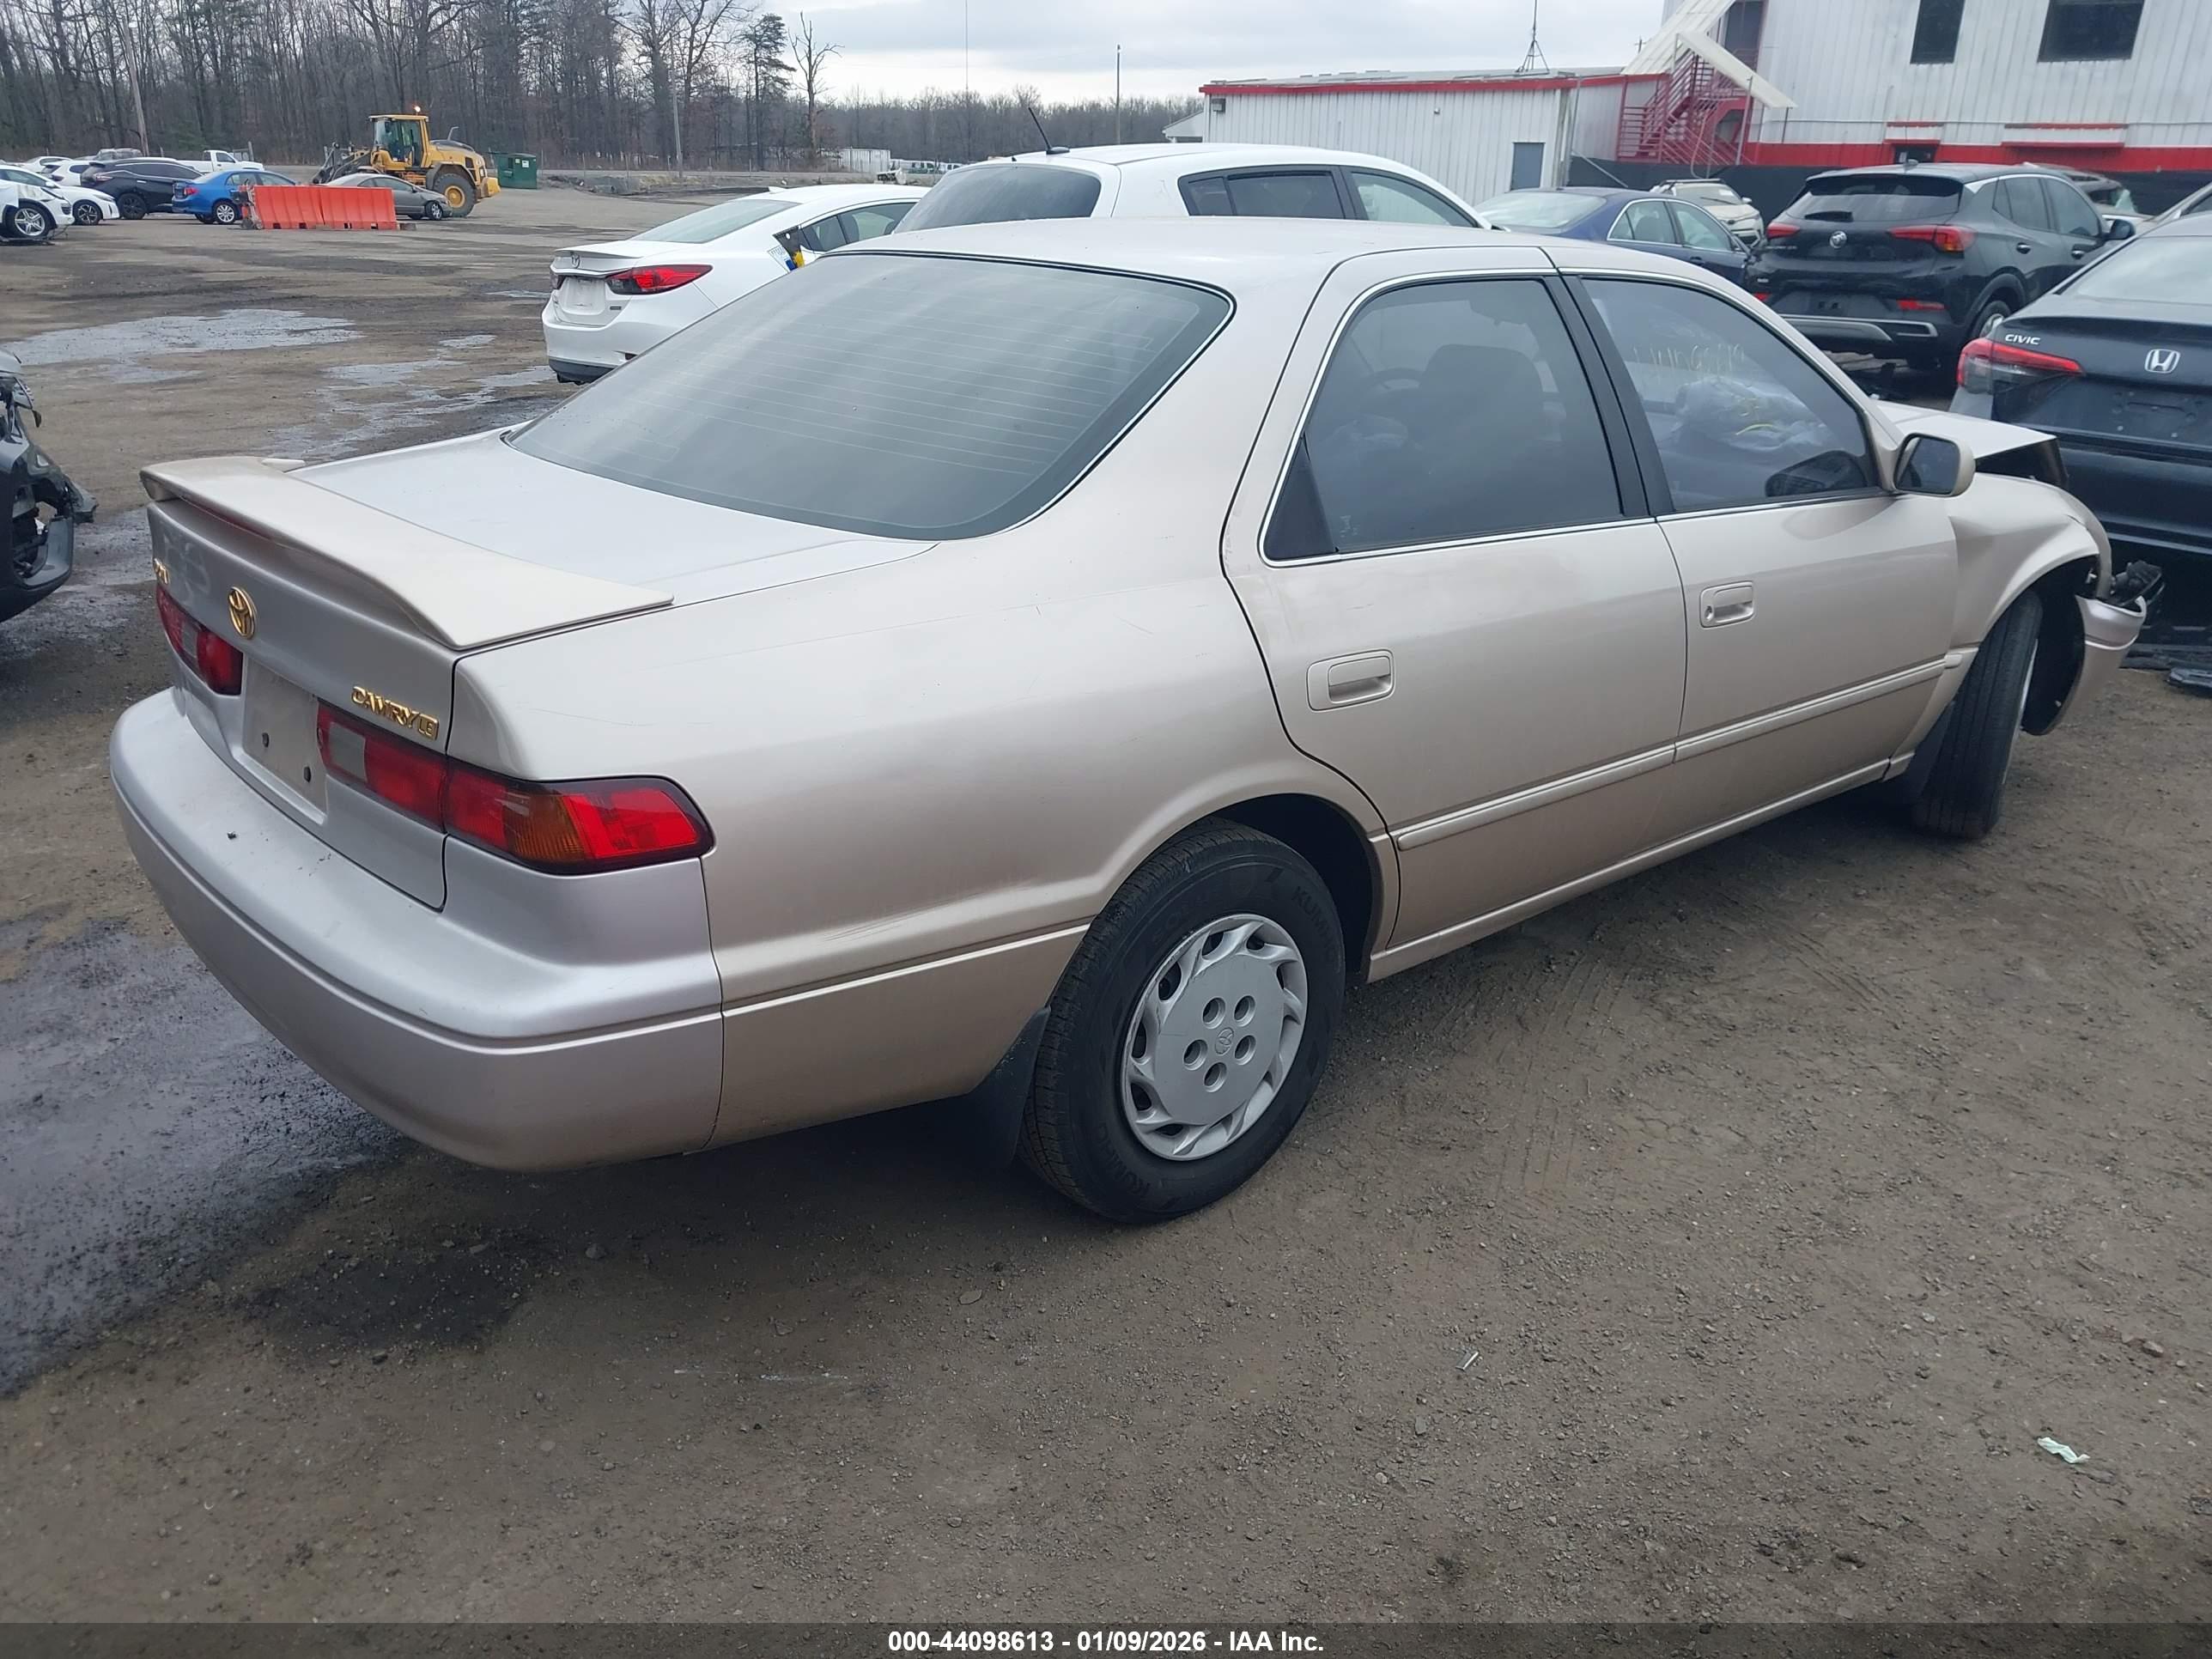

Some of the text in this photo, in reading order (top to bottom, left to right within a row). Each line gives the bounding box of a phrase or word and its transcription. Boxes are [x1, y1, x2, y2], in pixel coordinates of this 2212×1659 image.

[2005, 333, 2041, 345] CIVIC
[352, 686, 436, 738] CAMRY LE
